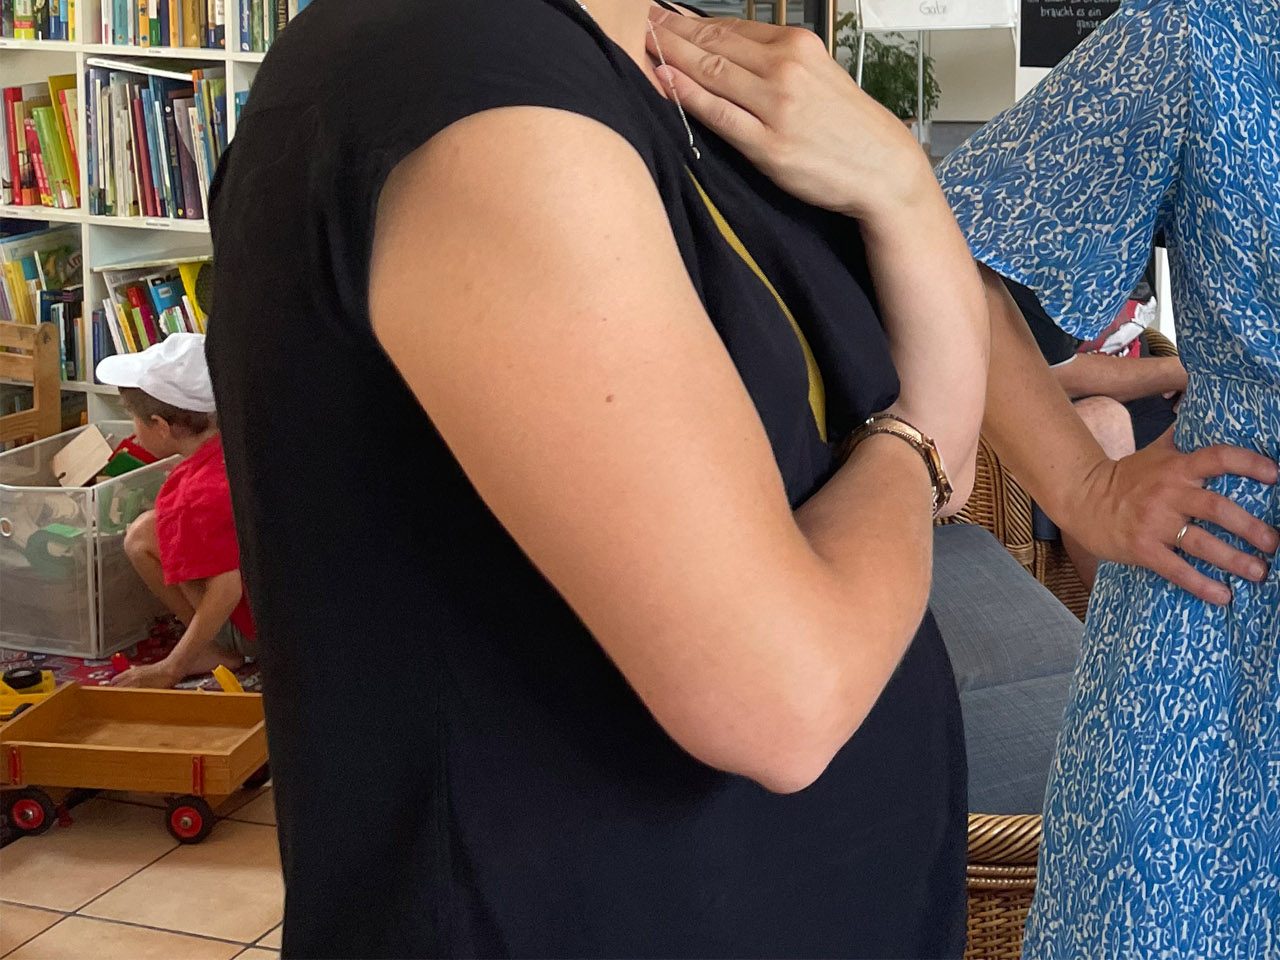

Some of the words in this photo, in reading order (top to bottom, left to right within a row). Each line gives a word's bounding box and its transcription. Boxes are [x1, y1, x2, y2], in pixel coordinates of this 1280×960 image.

[1040, 5, 1074, 18] braucht
[1076, 8, 1085, 17] es
[1088, 7, 1102, 17] ein
[1076, 19, 1103, 35] ganze
